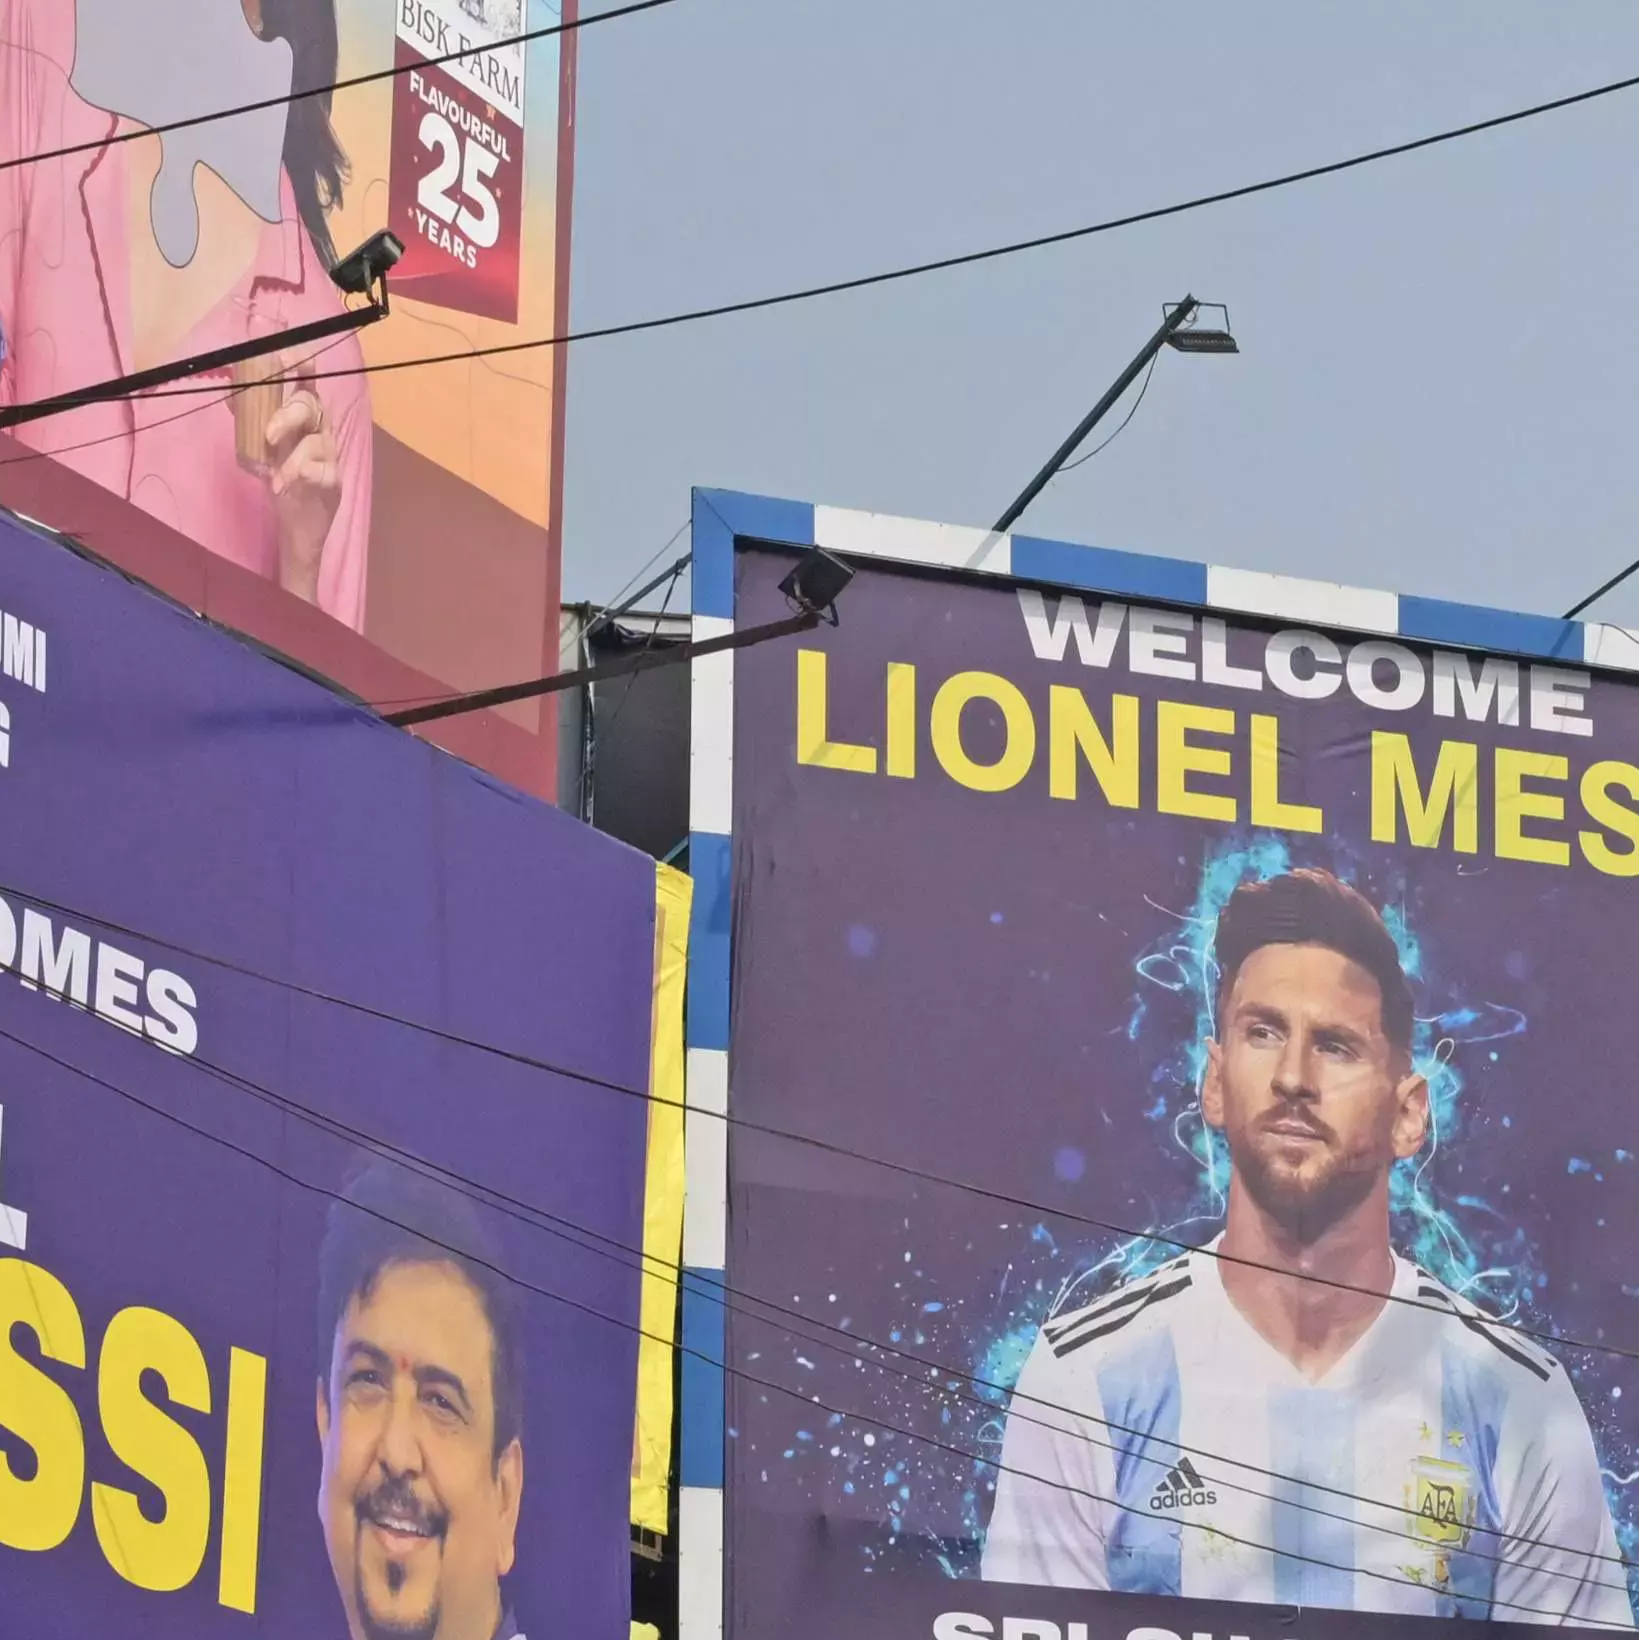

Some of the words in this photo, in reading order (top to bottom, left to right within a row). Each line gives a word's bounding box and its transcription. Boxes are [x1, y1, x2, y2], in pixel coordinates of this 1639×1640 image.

[401, 0, 451, 57] BISK
[458, 32, 521, 109] FARM
[410, 70, 510, 162] FLAVOURFUL
[418, 112, 499, 248] 25
[415, 207, 477, 269] YEARS
[1014, 588, 1595, 739] WELCOME
[796, 648, 1323, 835] LIONEL
[1149, 1482, 1217, 1511] adidas
